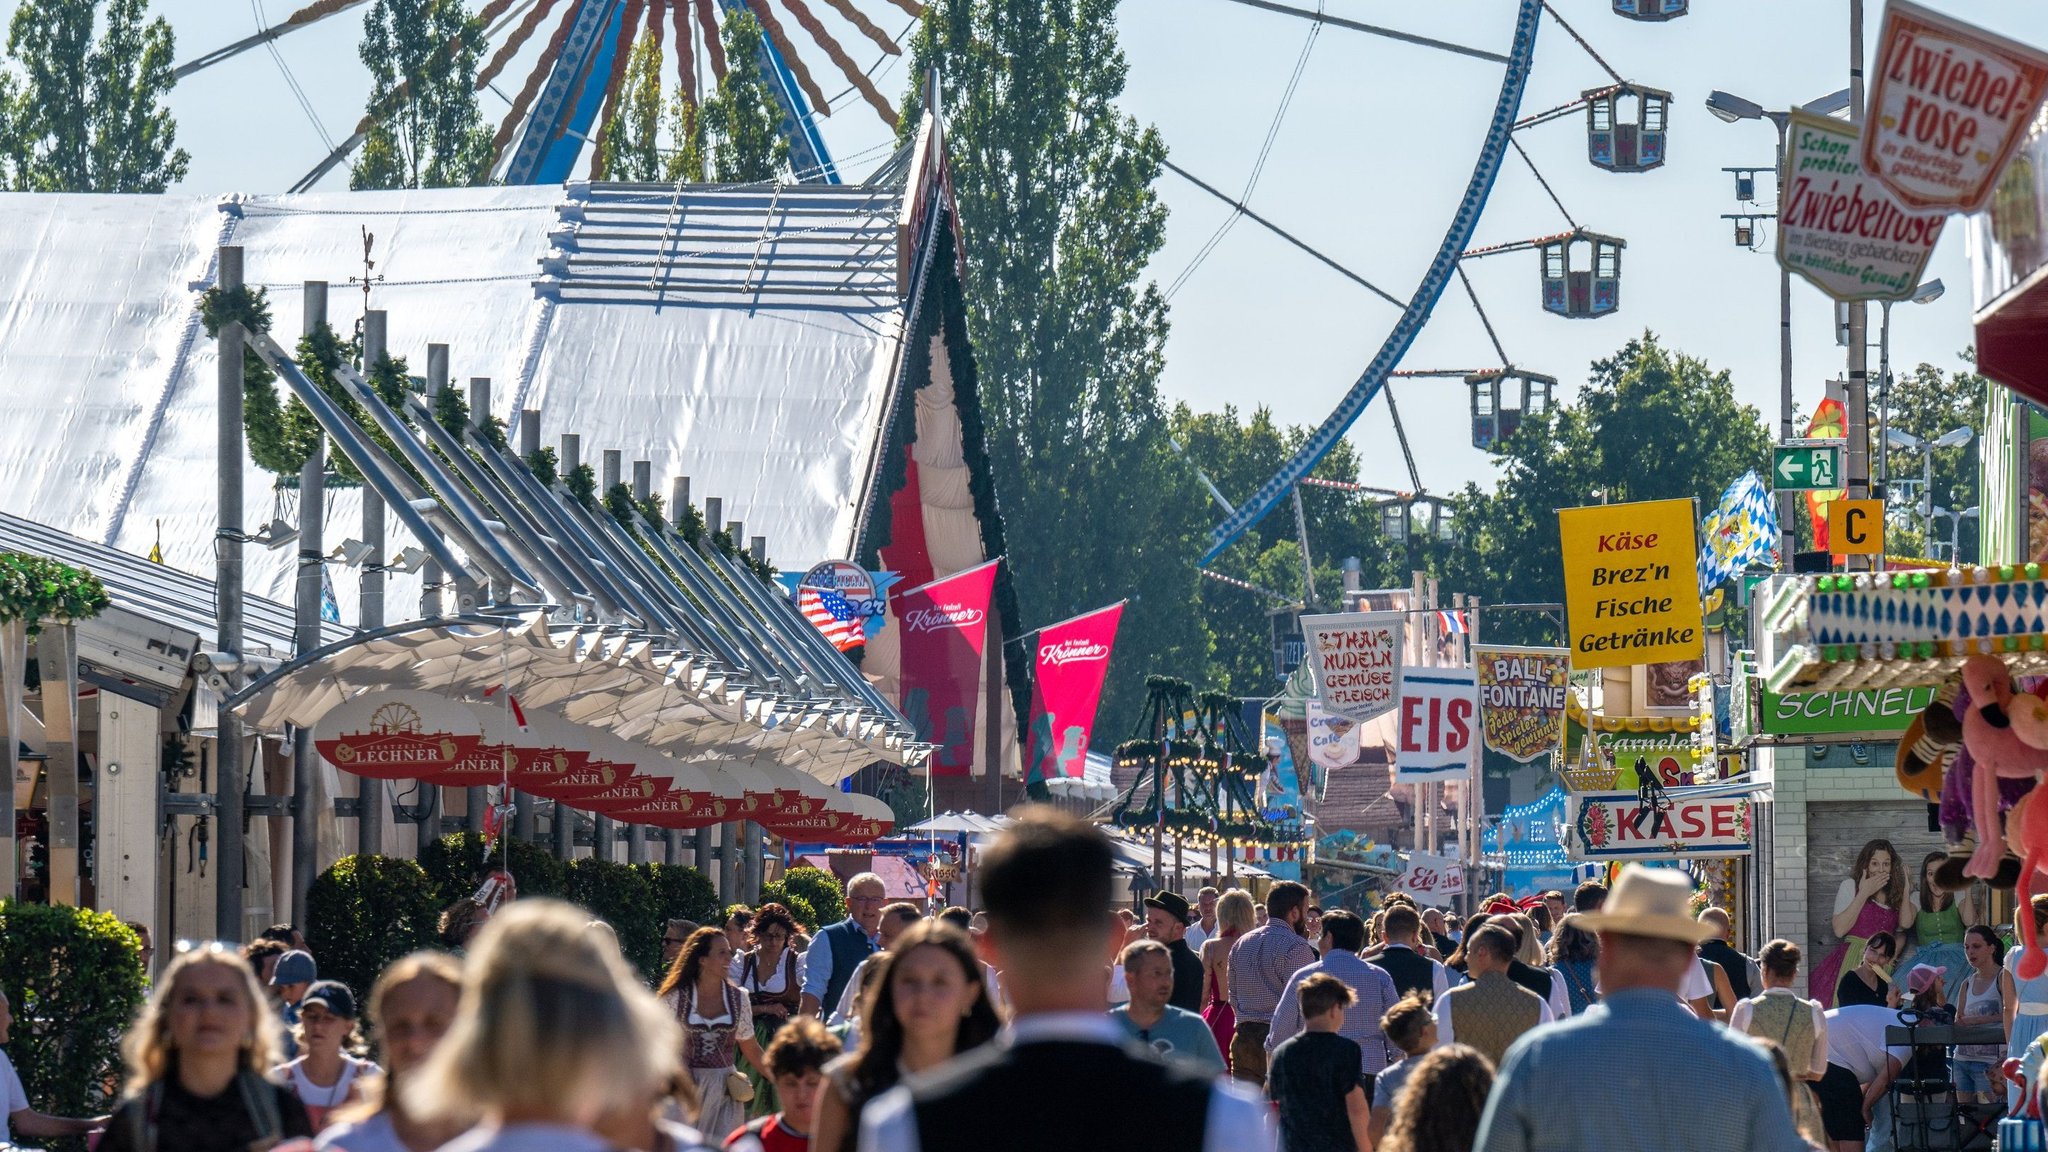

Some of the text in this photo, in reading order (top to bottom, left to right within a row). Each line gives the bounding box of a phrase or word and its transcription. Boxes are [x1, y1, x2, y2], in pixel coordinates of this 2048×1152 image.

[1889, 31, 2028, 121] Zwiebel-
[1897, 95, 1978, 157] rose
[1799, 131, 1850, 154] Schon
[1782, 176, 1944, 247] Zwiebelrose
[1848, 240, 1919, 265] gebacken
[1846, 508, 1867, 544] C
[1597, 531, 1659, 553] Käse
[809, 574, 866, 587] AMERICAN
[1592, 563, 1670, 587] Brez'n
[1595, 596, 1672, 619] Fische
[1332, 629, 1378, 650] THAI
[1579, 627, 1694, 653] Getränke
[1040, 643, 1109, 667] Krönner
[1323, 650, 1393, 671] NUDELN
[1326, 670, 1392, 688] GEMÜSE
[1494, 658, 1553, 683] BALL-
[1480, 681, 1566, 709] FONTÄNE
[1401, 696, 1473, 753] EIS
[1489, 709, 1519, 735] Jeder
[1500, 718, 1537, 745] Spieler
[1514, 715, 1560, 754] gewinnt!
[356, 748, 438, 763] LECHNER
[1616, 803, 1736, 841] KÄSE
[1408, 866, 1439, 892] Eis
